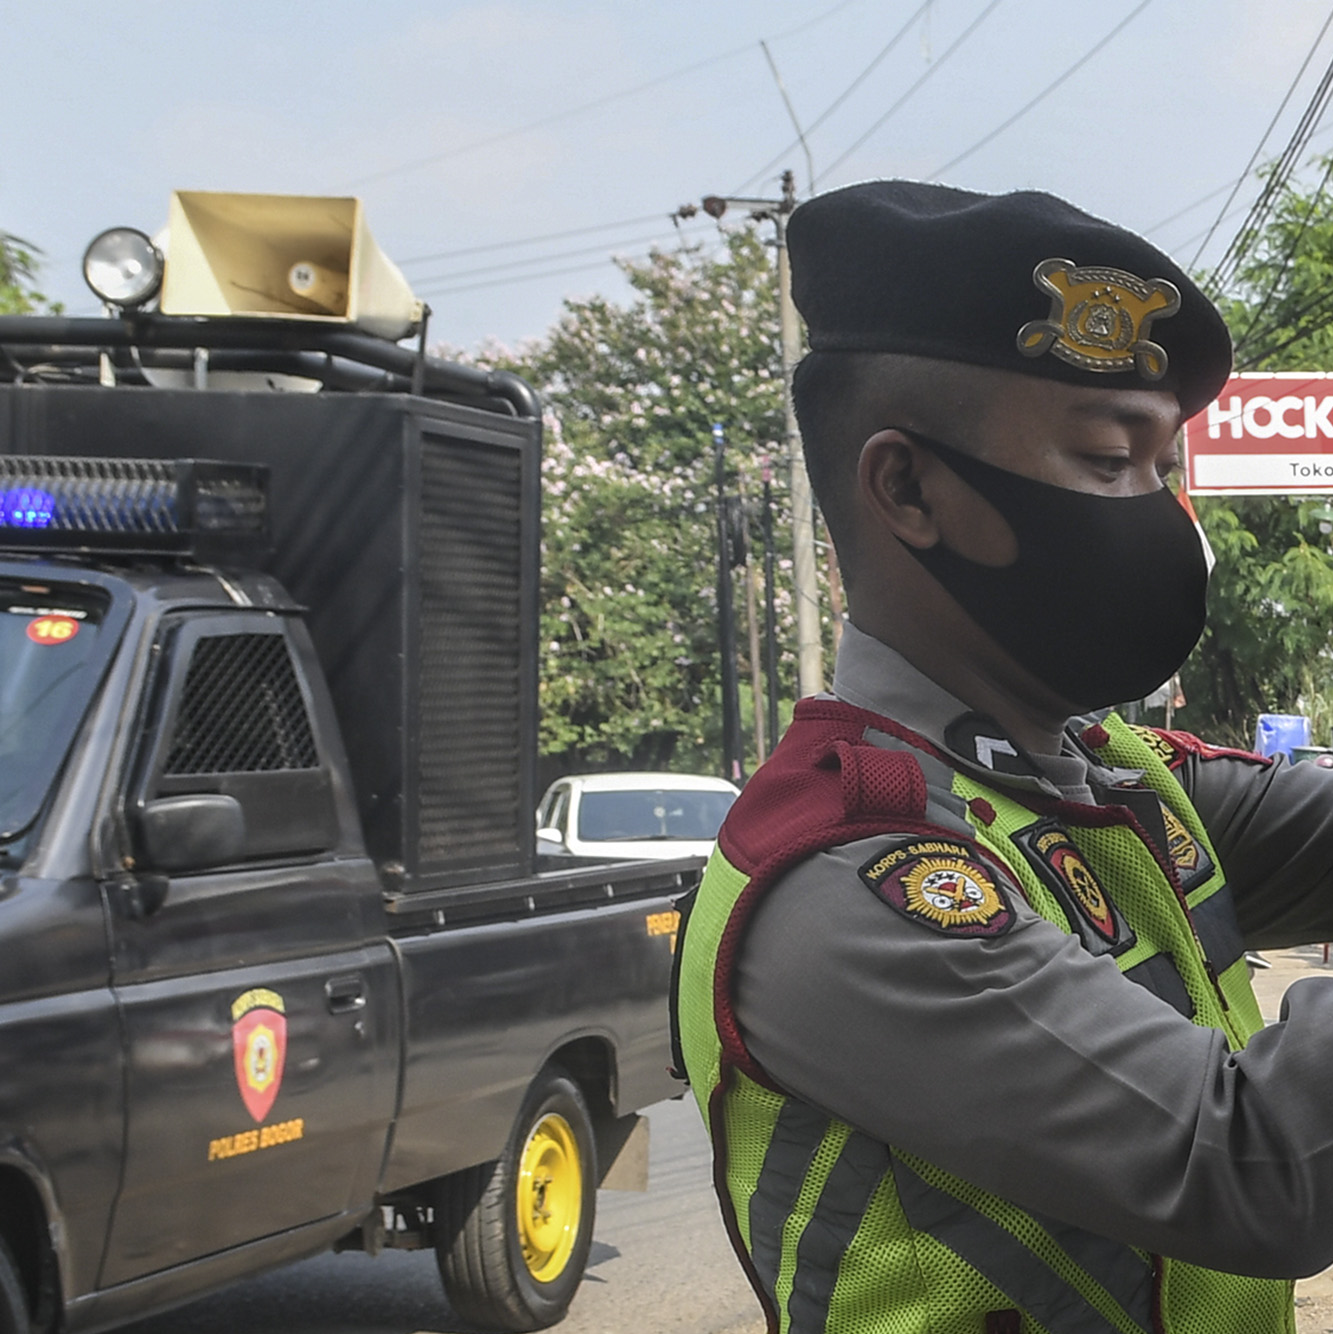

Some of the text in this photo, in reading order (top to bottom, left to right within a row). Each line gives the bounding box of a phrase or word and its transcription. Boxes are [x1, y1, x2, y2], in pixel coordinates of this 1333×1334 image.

[34, 620, 74, 639] 16
[866, 841, 970, 880] KORPS SABHARA
